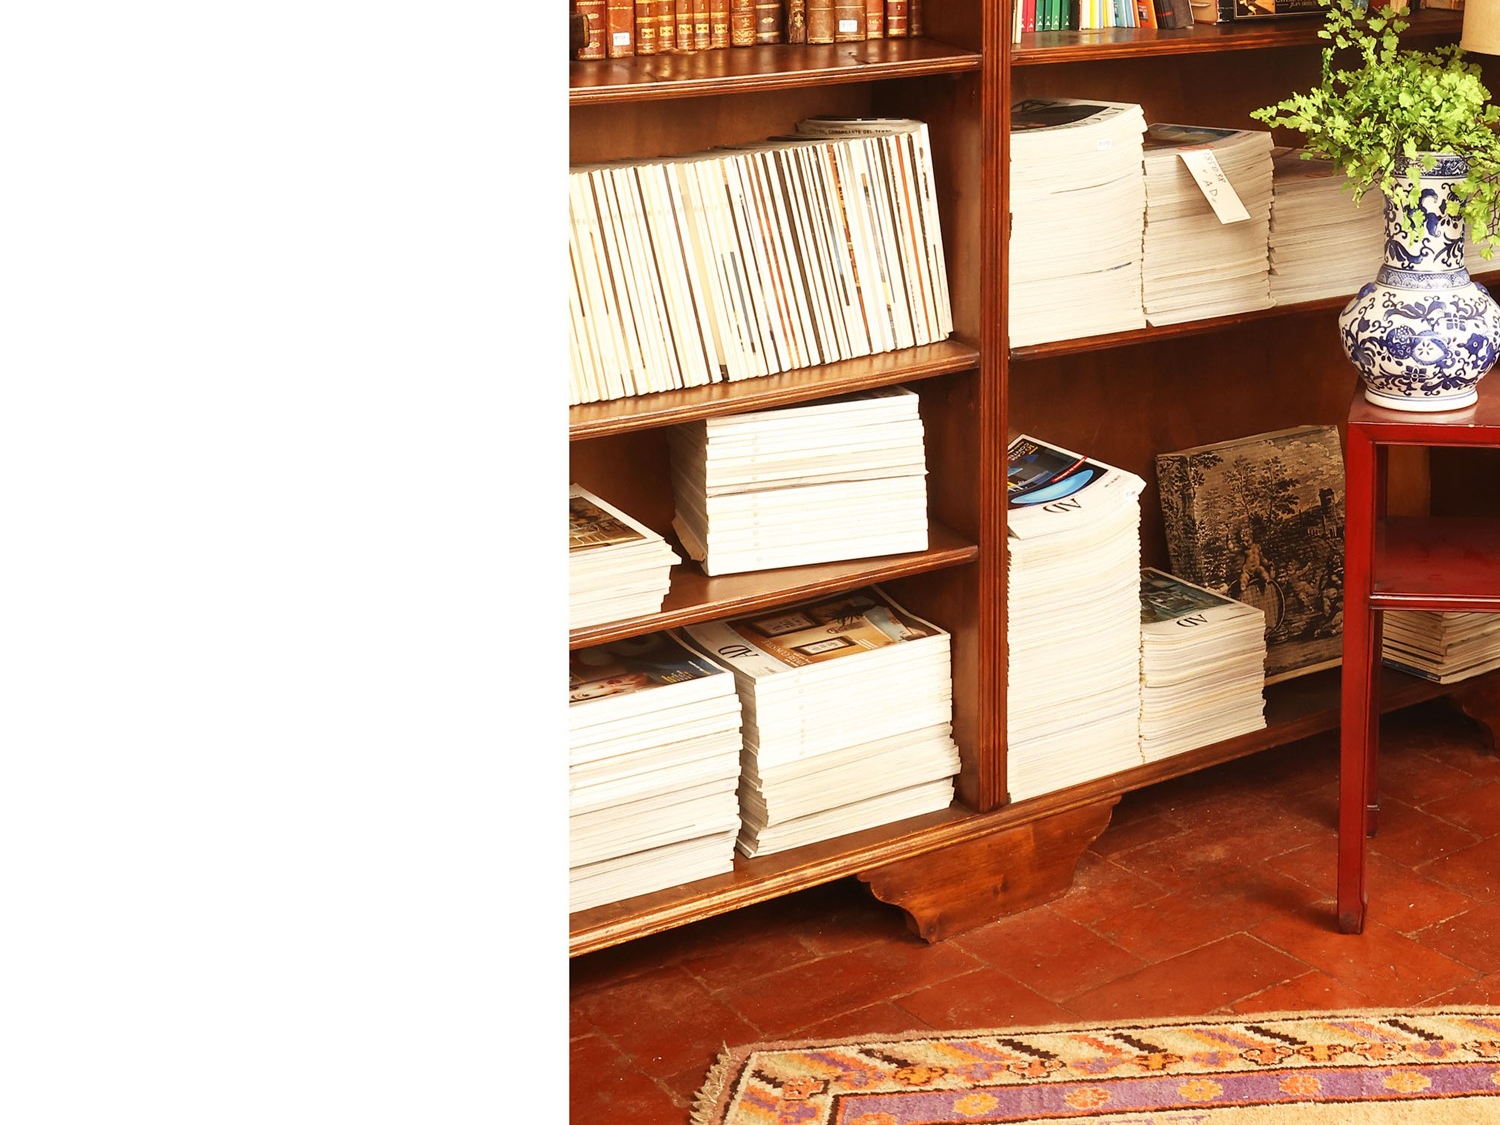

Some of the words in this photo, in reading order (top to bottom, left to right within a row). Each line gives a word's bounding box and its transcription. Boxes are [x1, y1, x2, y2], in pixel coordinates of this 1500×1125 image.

[1042, 498, 1083, 514] AD
[1176, 614, 1208, 628] AD
[718, 644, 760, 659] AD
